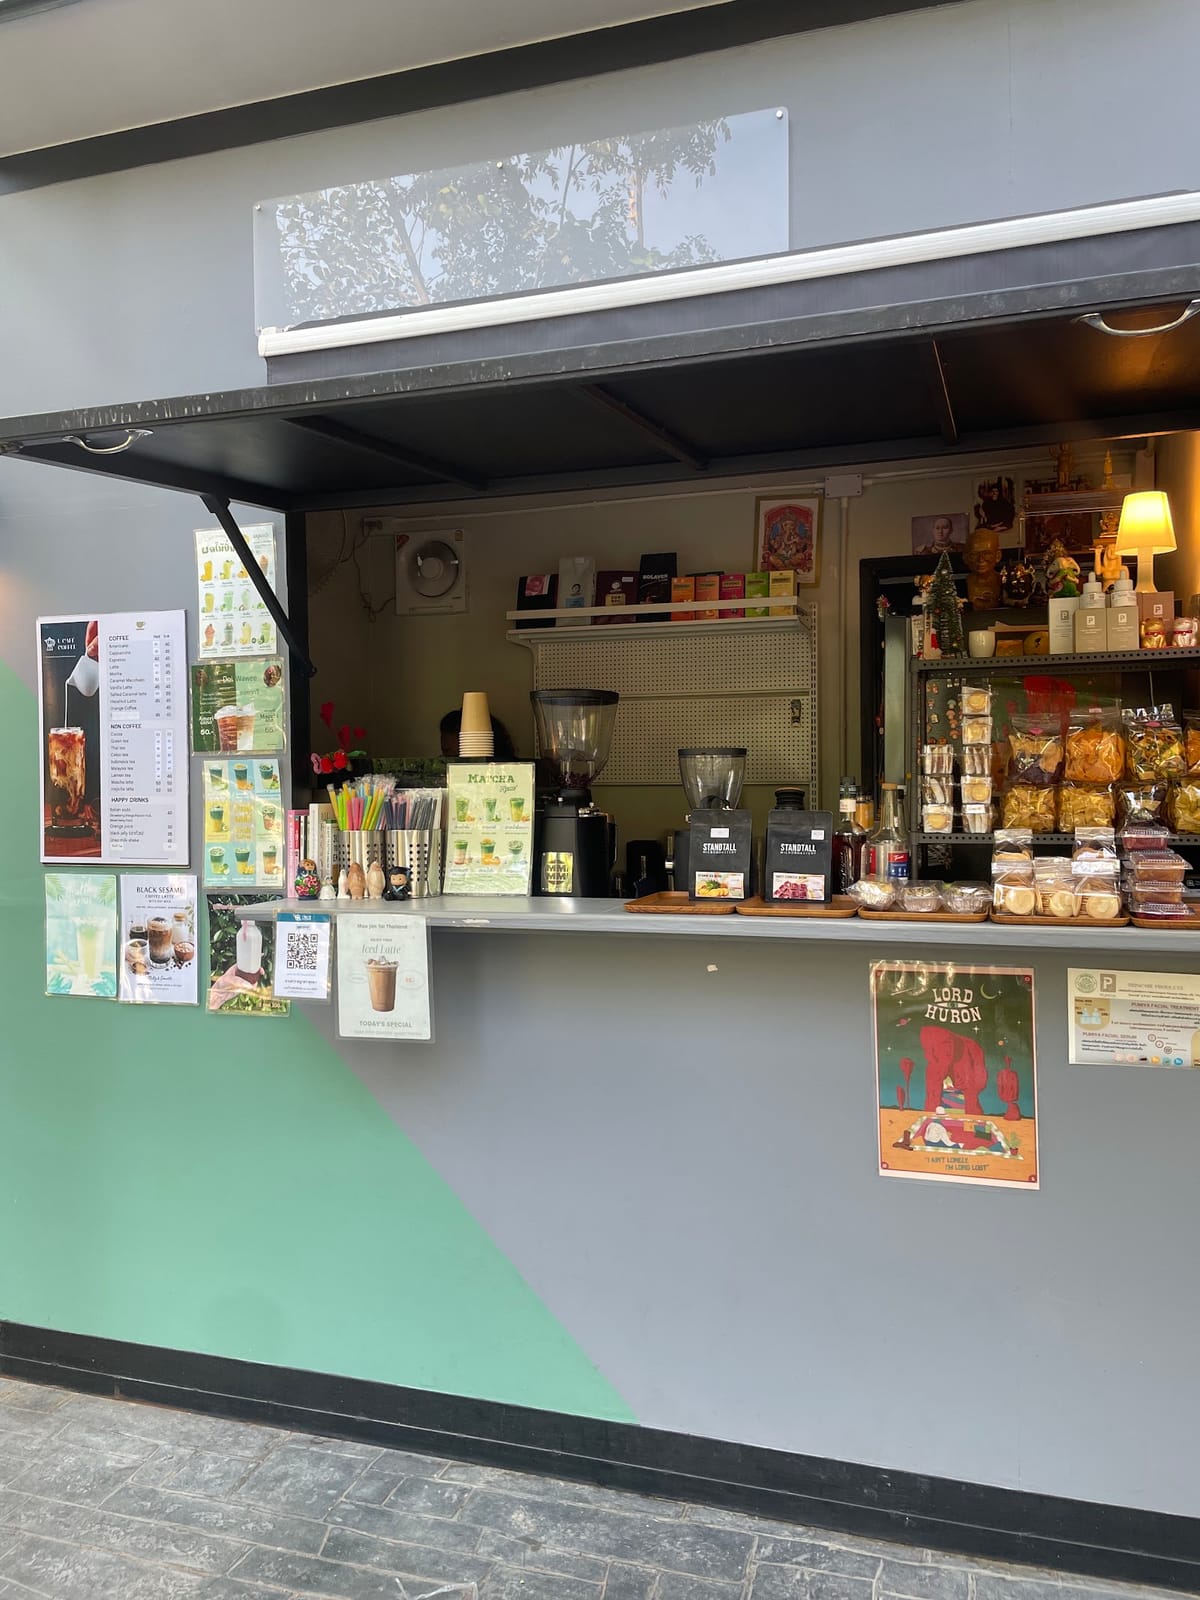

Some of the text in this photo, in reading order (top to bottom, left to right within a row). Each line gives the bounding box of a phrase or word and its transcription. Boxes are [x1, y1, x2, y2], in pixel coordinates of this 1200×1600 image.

[468, 774, 515, 783] MATCHA
[780, 843, 816, 851] STANDTALL
[362, 944, 401, 954] Iced Latte
[932, 988, 974, 1002] LORD
[924, 1004, 982, 1023] HURON
